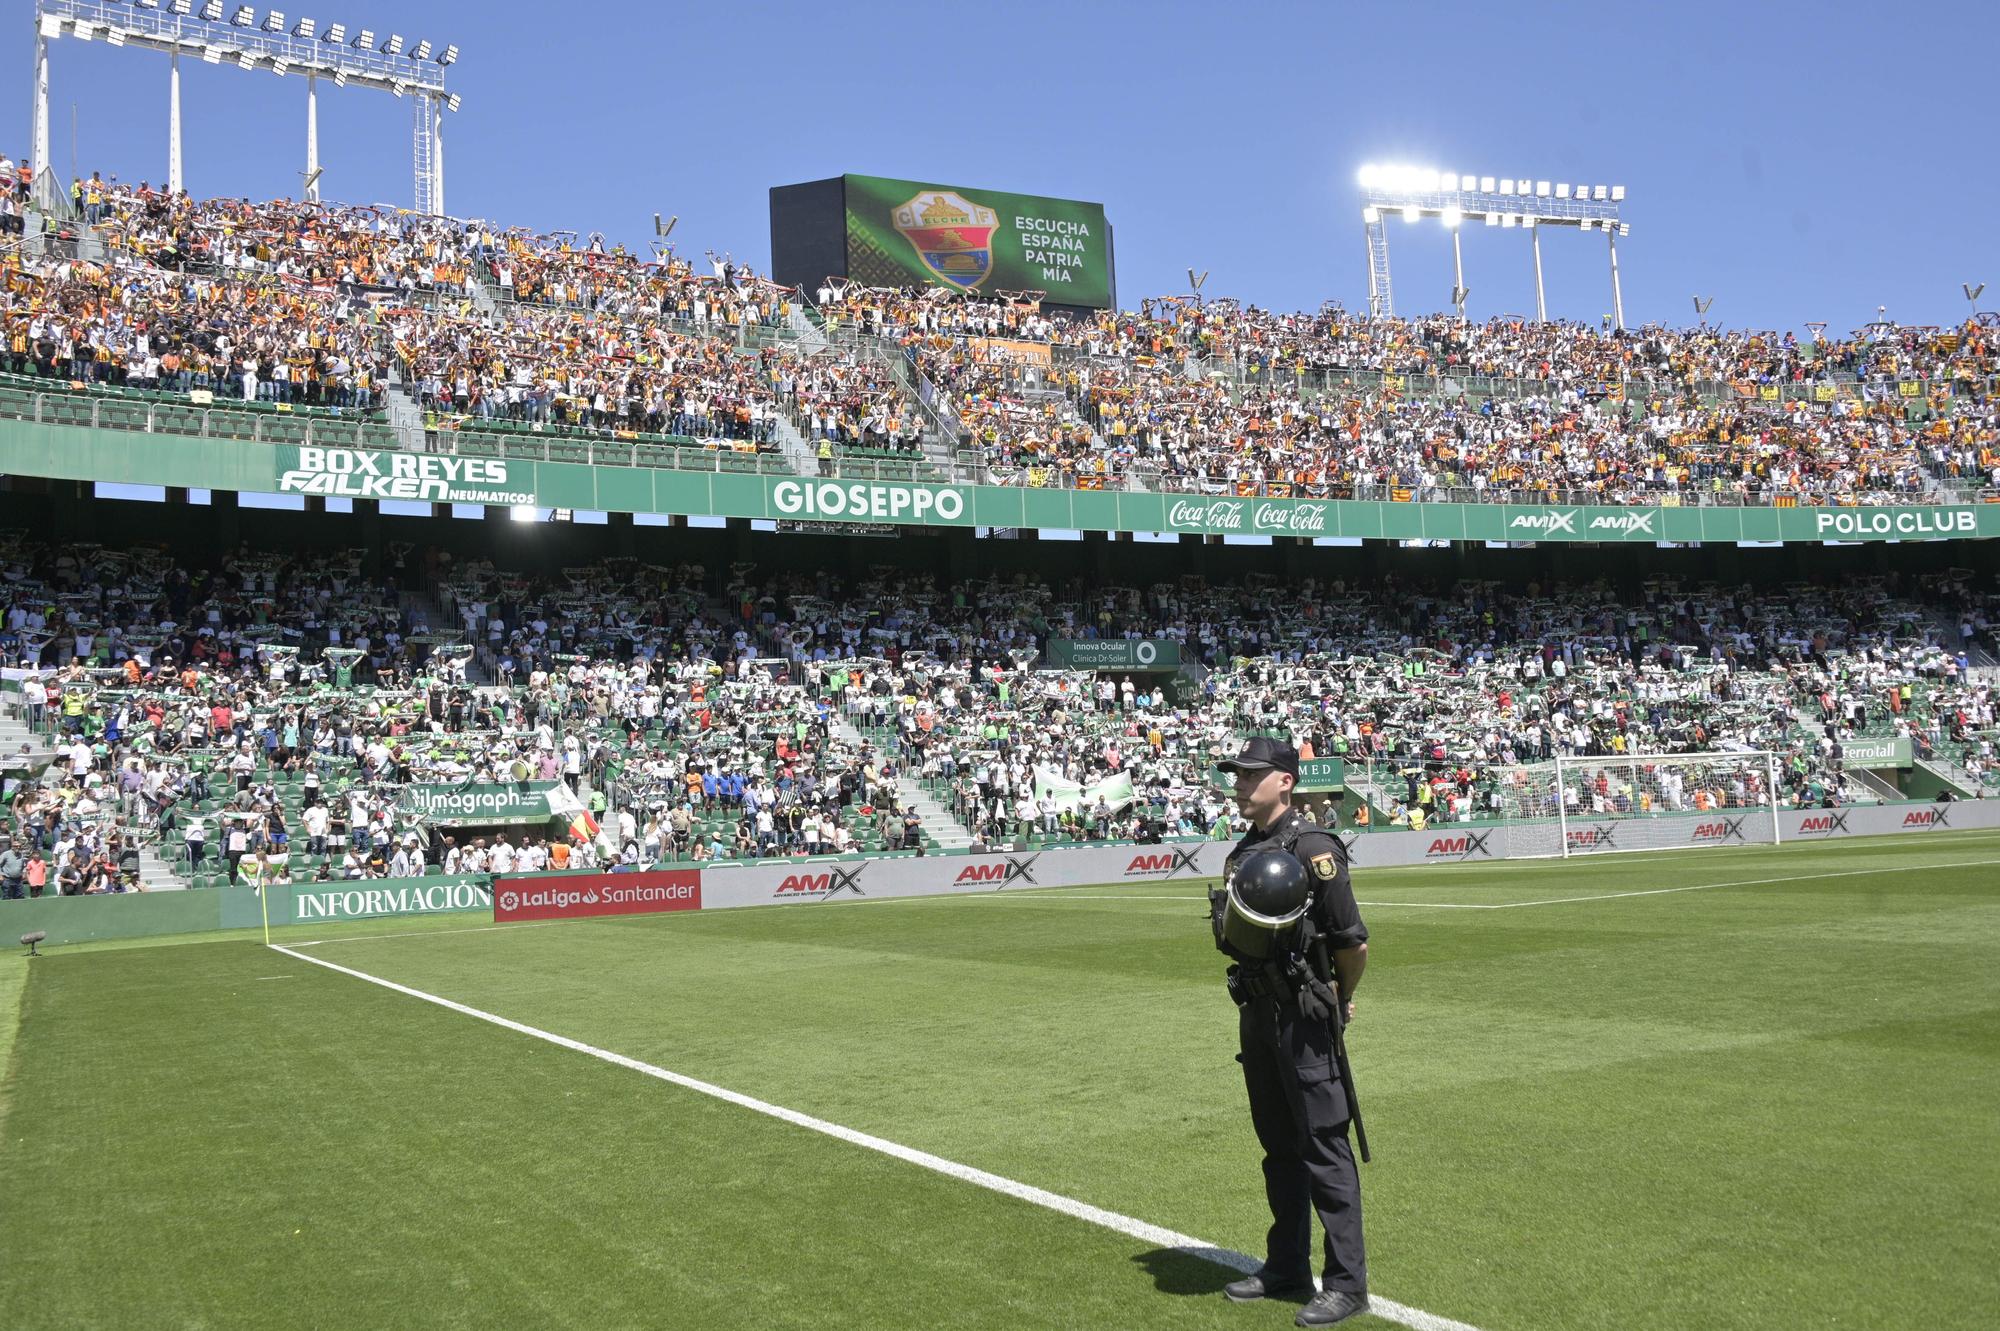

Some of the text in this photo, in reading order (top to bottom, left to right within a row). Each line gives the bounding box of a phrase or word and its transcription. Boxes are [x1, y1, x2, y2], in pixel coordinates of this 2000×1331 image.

[1015, 216, 1089, 237] ESCUCHA
[1022, 233, 1085, 252] ESPAÑA
[1025, 249, 1083, 267] PATRIA
[1043, 265, 1072, 283] MÍA
[299, 446, 507, 484] BOX REYES
[449, 488, 535, 504] NEUMATICOS
[773, 481, 964, 520] GIOSEPPO
[1510, 508, 1576, 534] AMIX
[1589, 508, 1655, 534] AMIX
[1817, 511, 1976, 533] POLO CLUB
[1073, 641, 1126, 651] Innova Ocular
[1176, 687, 1200, 701] SALIDA
[1842, 742, 1895, 759] Ferrotall
[1692, 814, 1748, 844] AMIX
[1799, 809, 1851, 837] AMIX
[1903, 803, 1951, 832] AMIX
[1427, 827, 1494, 861] AMIX
[954, 852, 1041, 891] AMIX
[1126, 843, 1205, 879] AMIX
[776, 861, 870, 901] AMIX
[297, 880, 491, 918] INFORMACIÓN
[522, 882, 695, 908] LaLiga Santander
